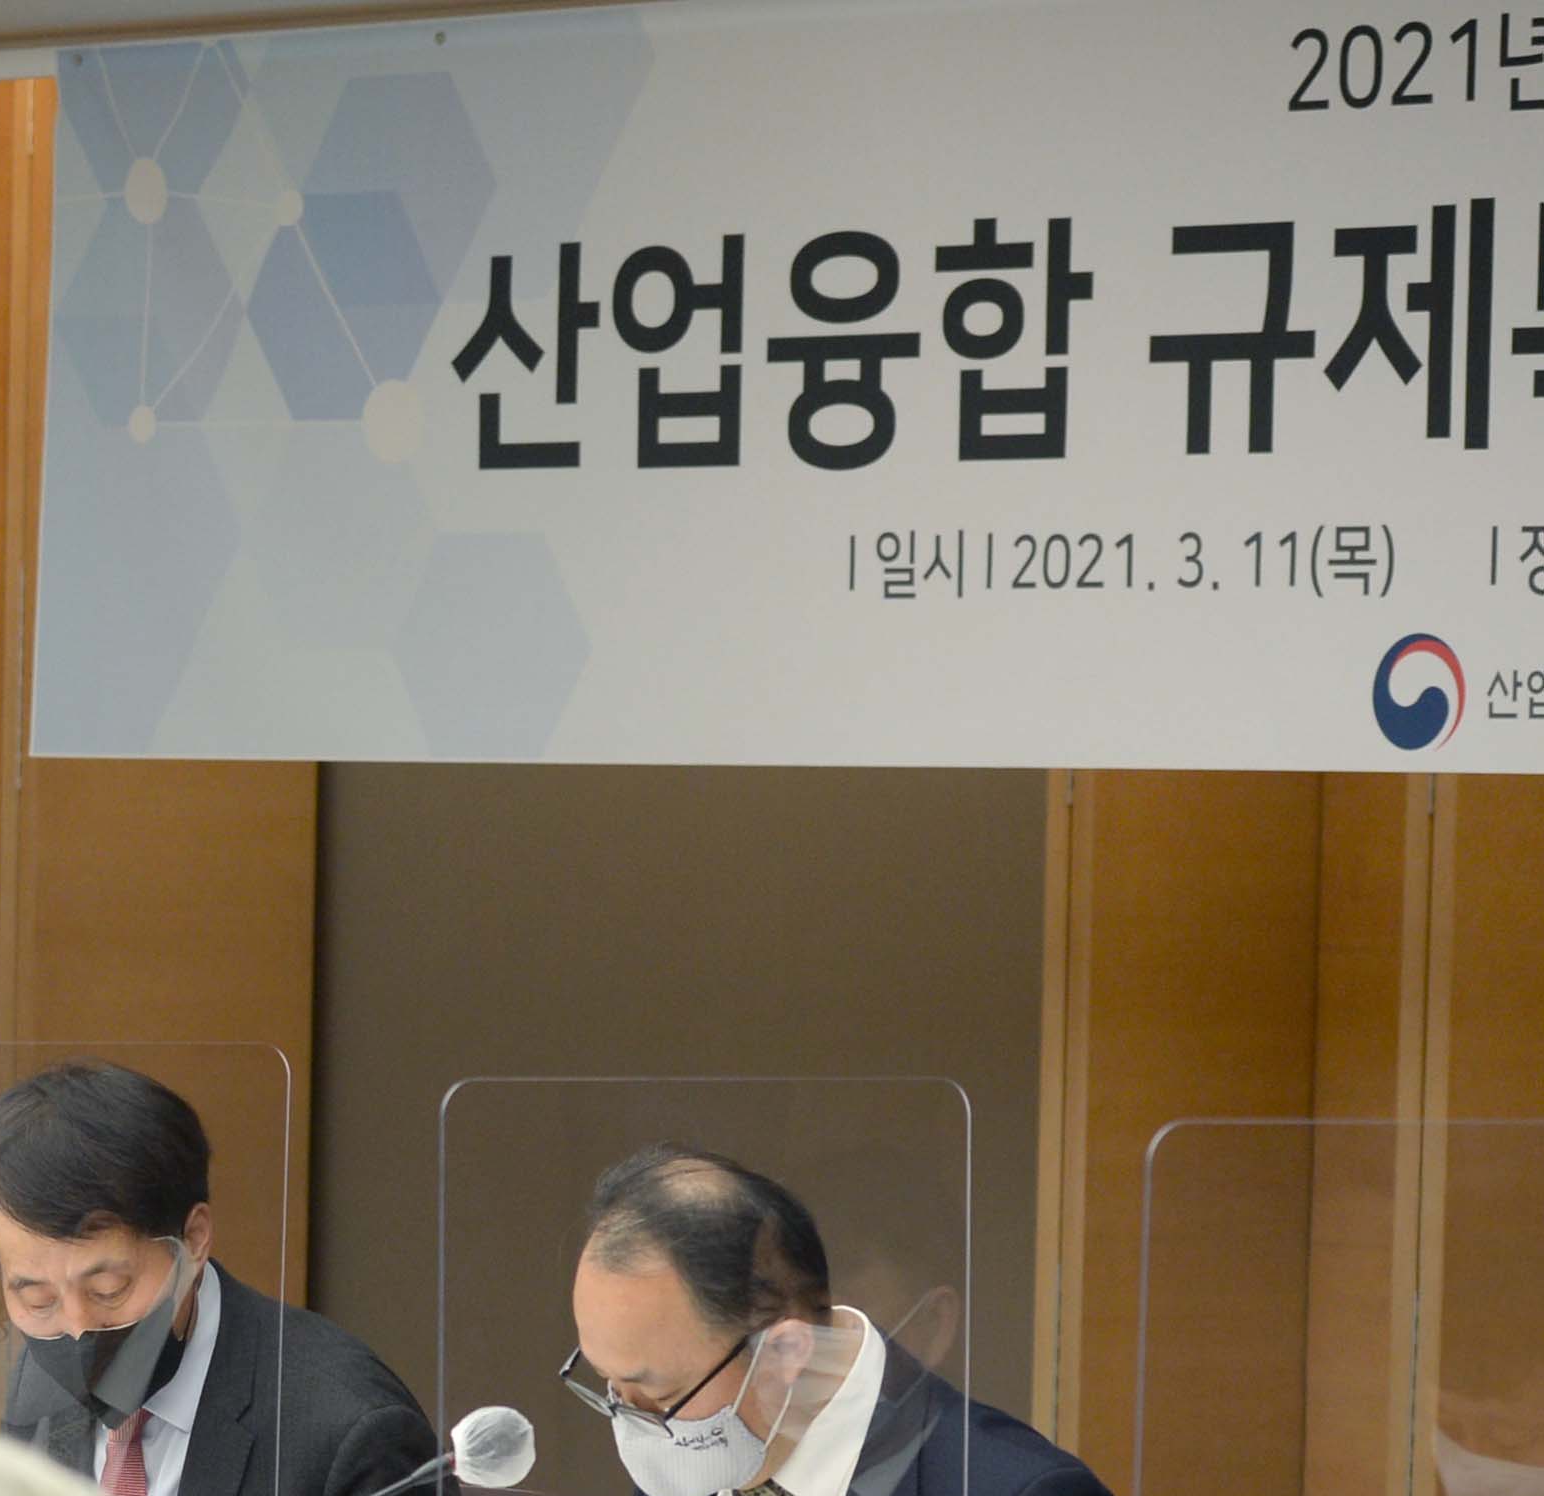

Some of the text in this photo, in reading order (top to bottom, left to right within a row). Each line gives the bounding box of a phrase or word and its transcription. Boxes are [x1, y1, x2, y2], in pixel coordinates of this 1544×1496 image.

[451, 197, 1544, 471] 산업융합 규제
[1243, 524, 1395, 598] 11(목)
